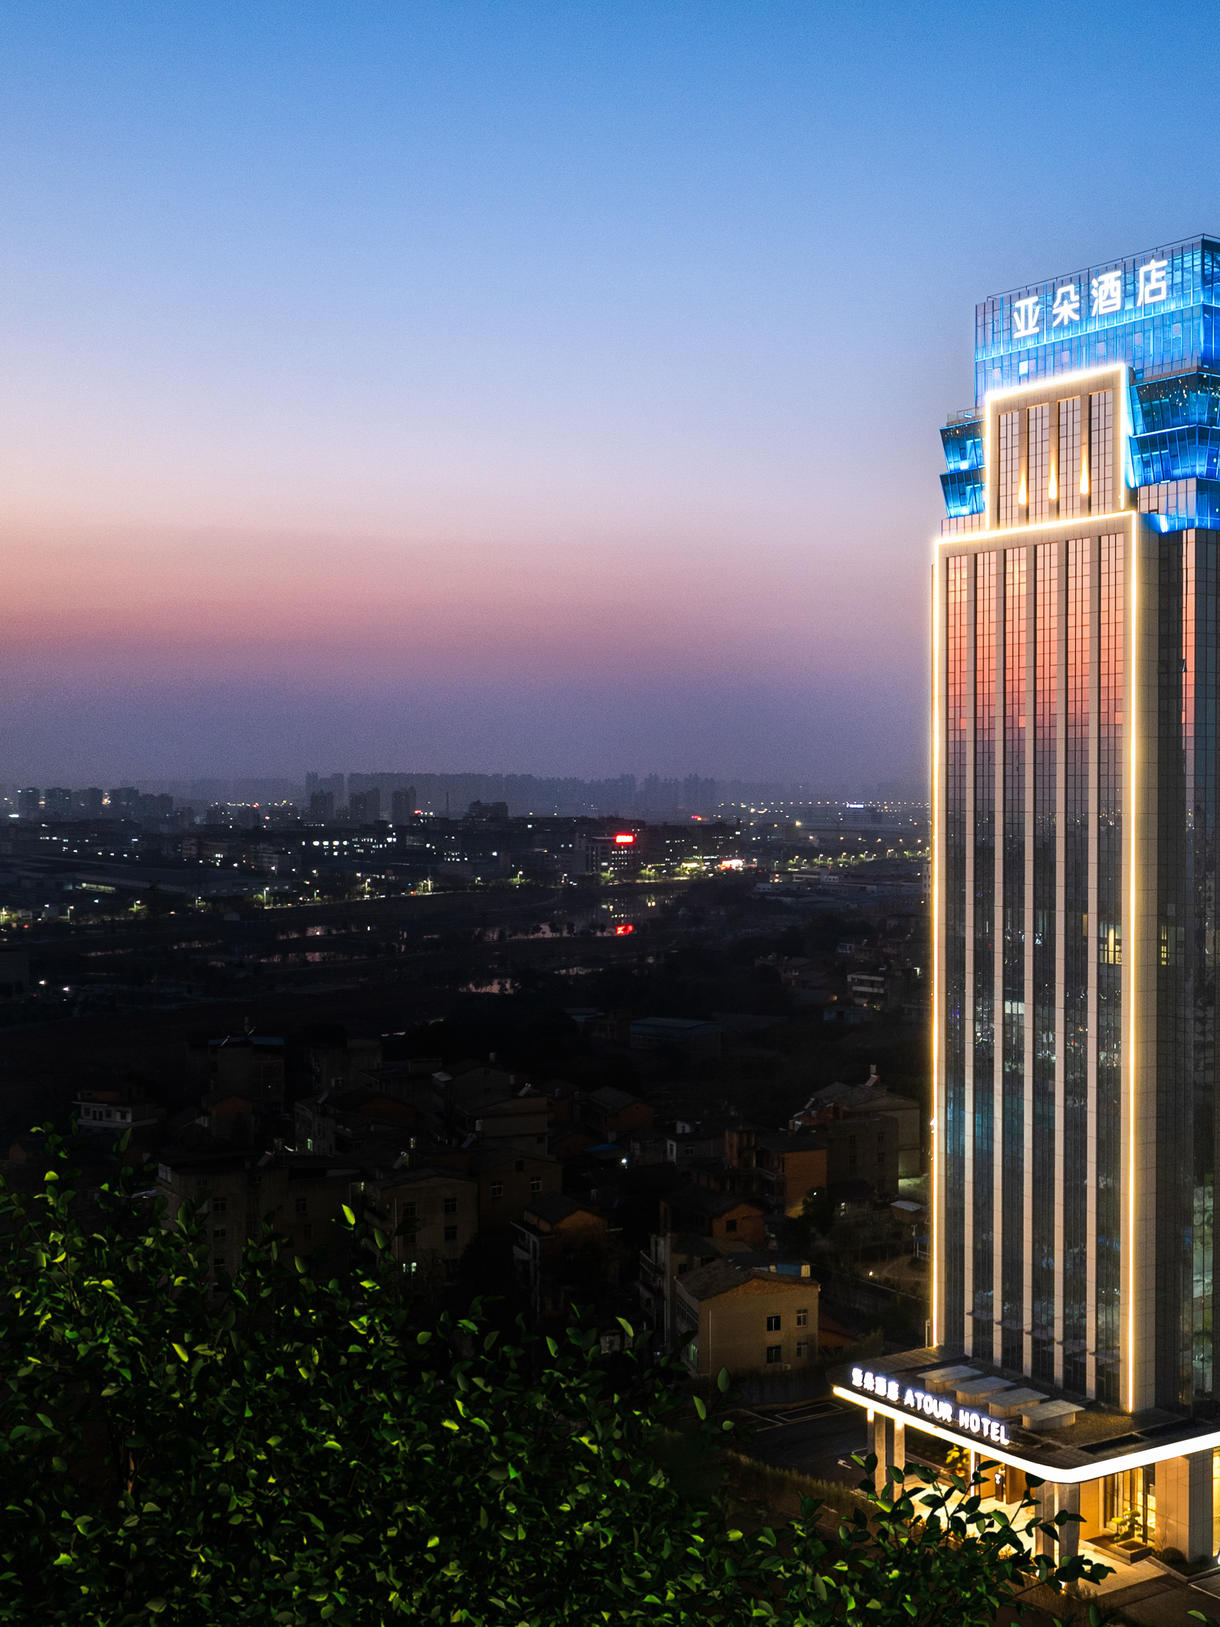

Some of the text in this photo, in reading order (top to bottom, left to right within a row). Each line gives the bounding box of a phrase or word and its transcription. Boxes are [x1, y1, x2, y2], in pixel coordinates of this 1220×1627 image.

[1013, 259, 1169, 339] 亚朵酒店
[904, 1389, 953, 1422] ATOUR
[959, 1409, 1010, 1445] HOTEL
